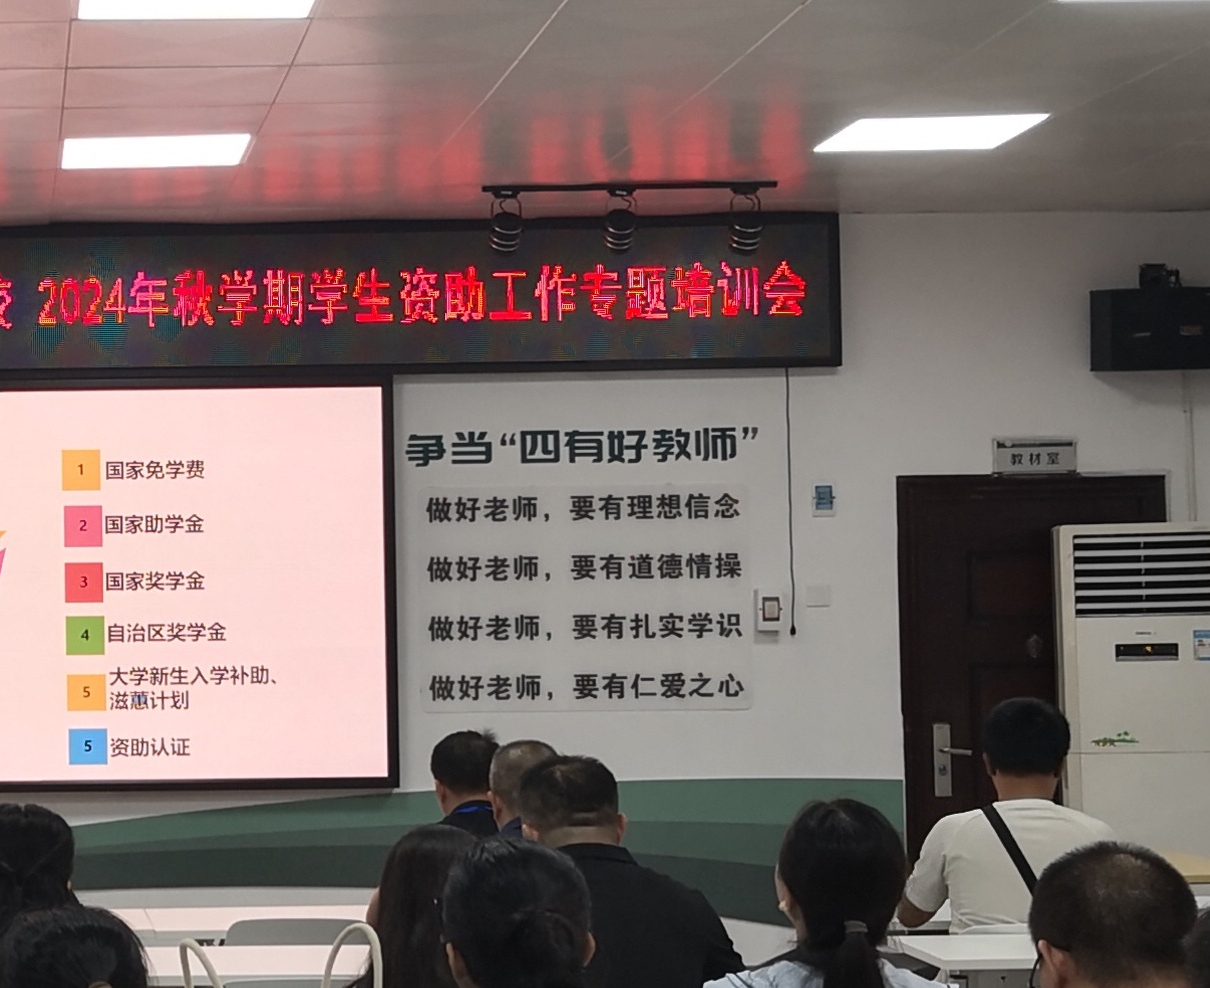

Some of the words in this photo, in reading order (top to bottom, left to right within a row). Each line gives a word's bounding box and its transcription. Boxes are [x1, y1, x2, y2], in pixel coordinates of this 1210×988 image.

[37, 260, 807, 328] 2024年秋学期学生资助工作专题培训会
[405, 427, 759, 467] 争当“四有好教师”
[1010, 452, 1060, 466] 教材室
[78, 464, 85, 475] 1
[105, 460, 205, 480] 国家免学费
[426, 493, 740, 523] 做好老师，要有理想信念
[79, 520, 88, 531] 2
[105, 514, 205, 535] 国家助学金
[80, 576, 88, 588] 3
[105, 571, 205, 591] 国家奖学金
[427, 552, 742, 582] 做好老师，要有道德情操
[80, 629, 90, 641] 4
[107, 622, 227, 643] 自治区奖学金
[428, 612, 744, 642] 做好老师，要有扎实学识
[82, 686, 91, 698] 5
[109, 665, 277, 686] 大学新生入学补助、
[429, 672, 745, 701] 做好老师，要有仁爱之心
[83, 740, 93, 752] 5
[110, 737, 191, 757] 资助认证
